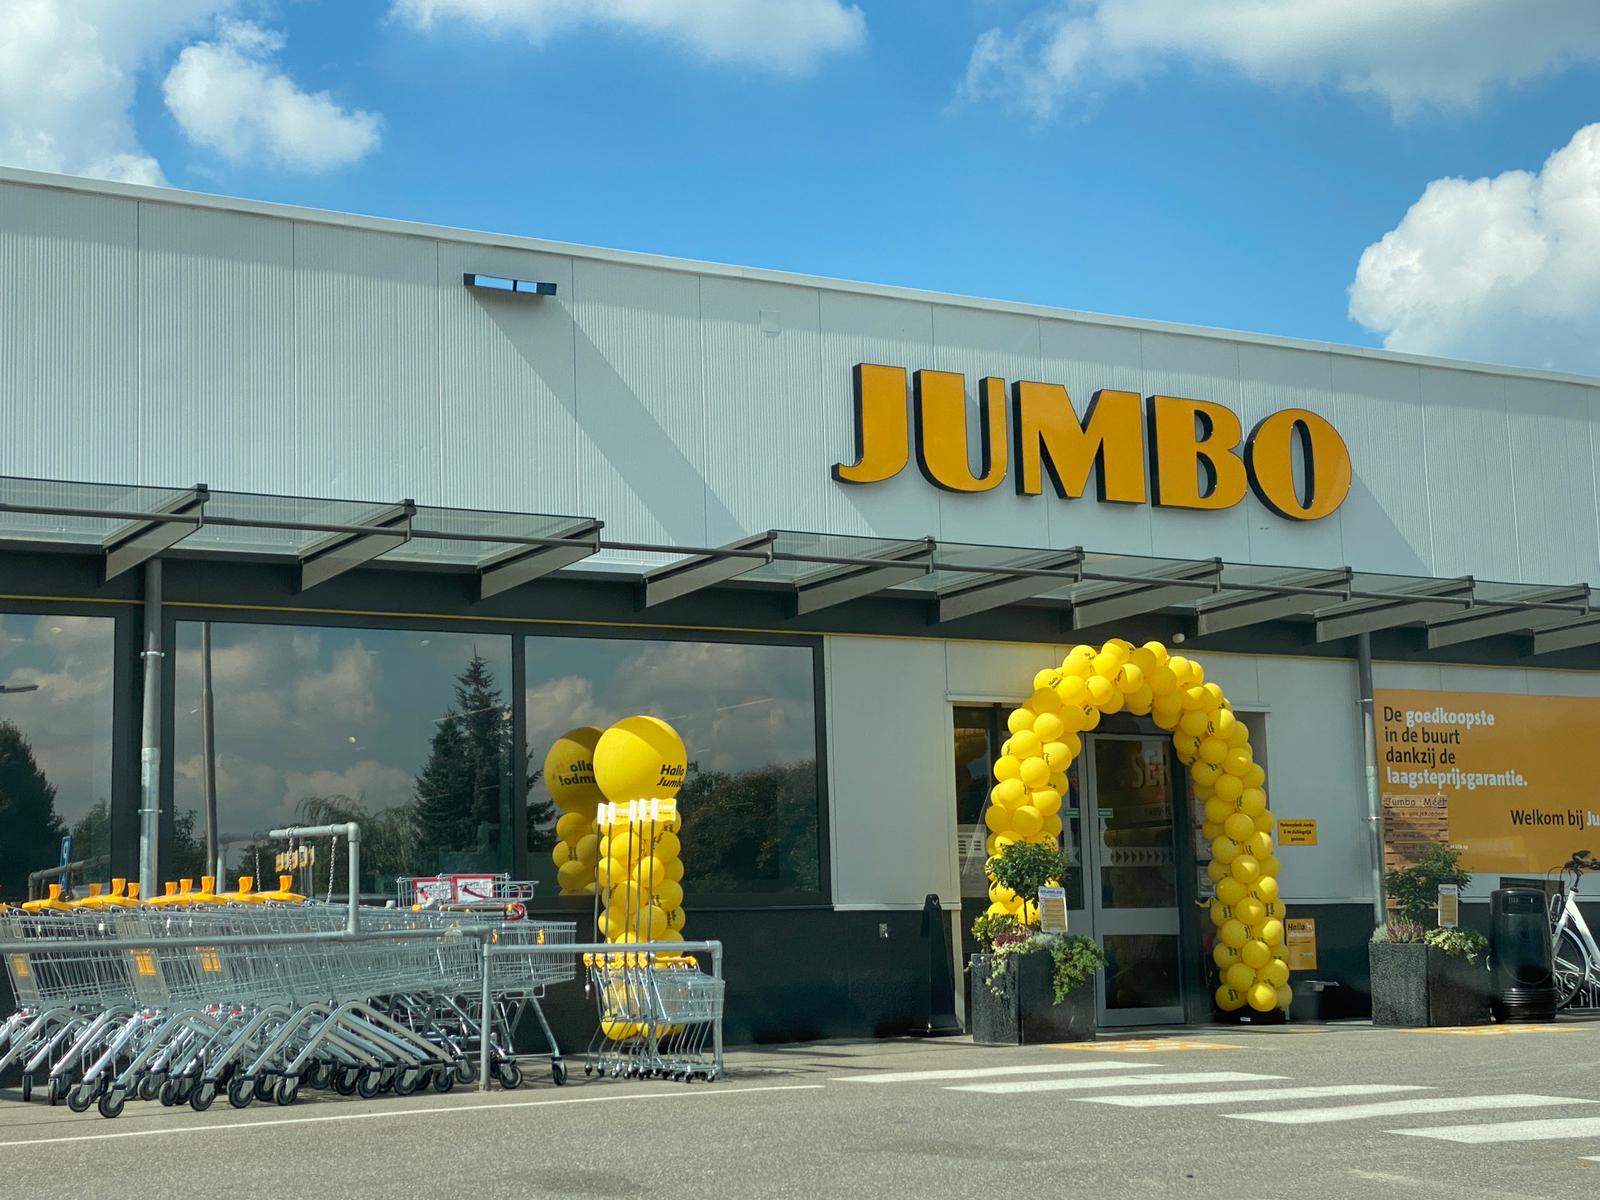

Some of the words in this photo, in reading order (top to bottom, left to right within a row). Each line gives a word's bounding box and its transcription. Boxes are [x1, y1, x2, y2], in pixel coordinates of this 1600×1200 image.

[832, 362, 1352, 521] JUMBO
[1384, 706, 1402, 722] De
[1406, 707, 1495, 729] goedkoopste
[1385, 726, 1397, 742] in
[1402, 726, 1418, 743] de
[1422, 727, 1460, 744] buurt
[1386, 746, 1436, 768] dankzij
[1440, 748, 1456, 764] de
[661, 764, 684, 776] Hallo
[1386, 766, 1528, 790] laagsteprijsgarantie.
[656, 776, 683, 788] Jumb
[1510, 809, 1564, 826] Welkom
[1568, 809, 1584, 831] bij
